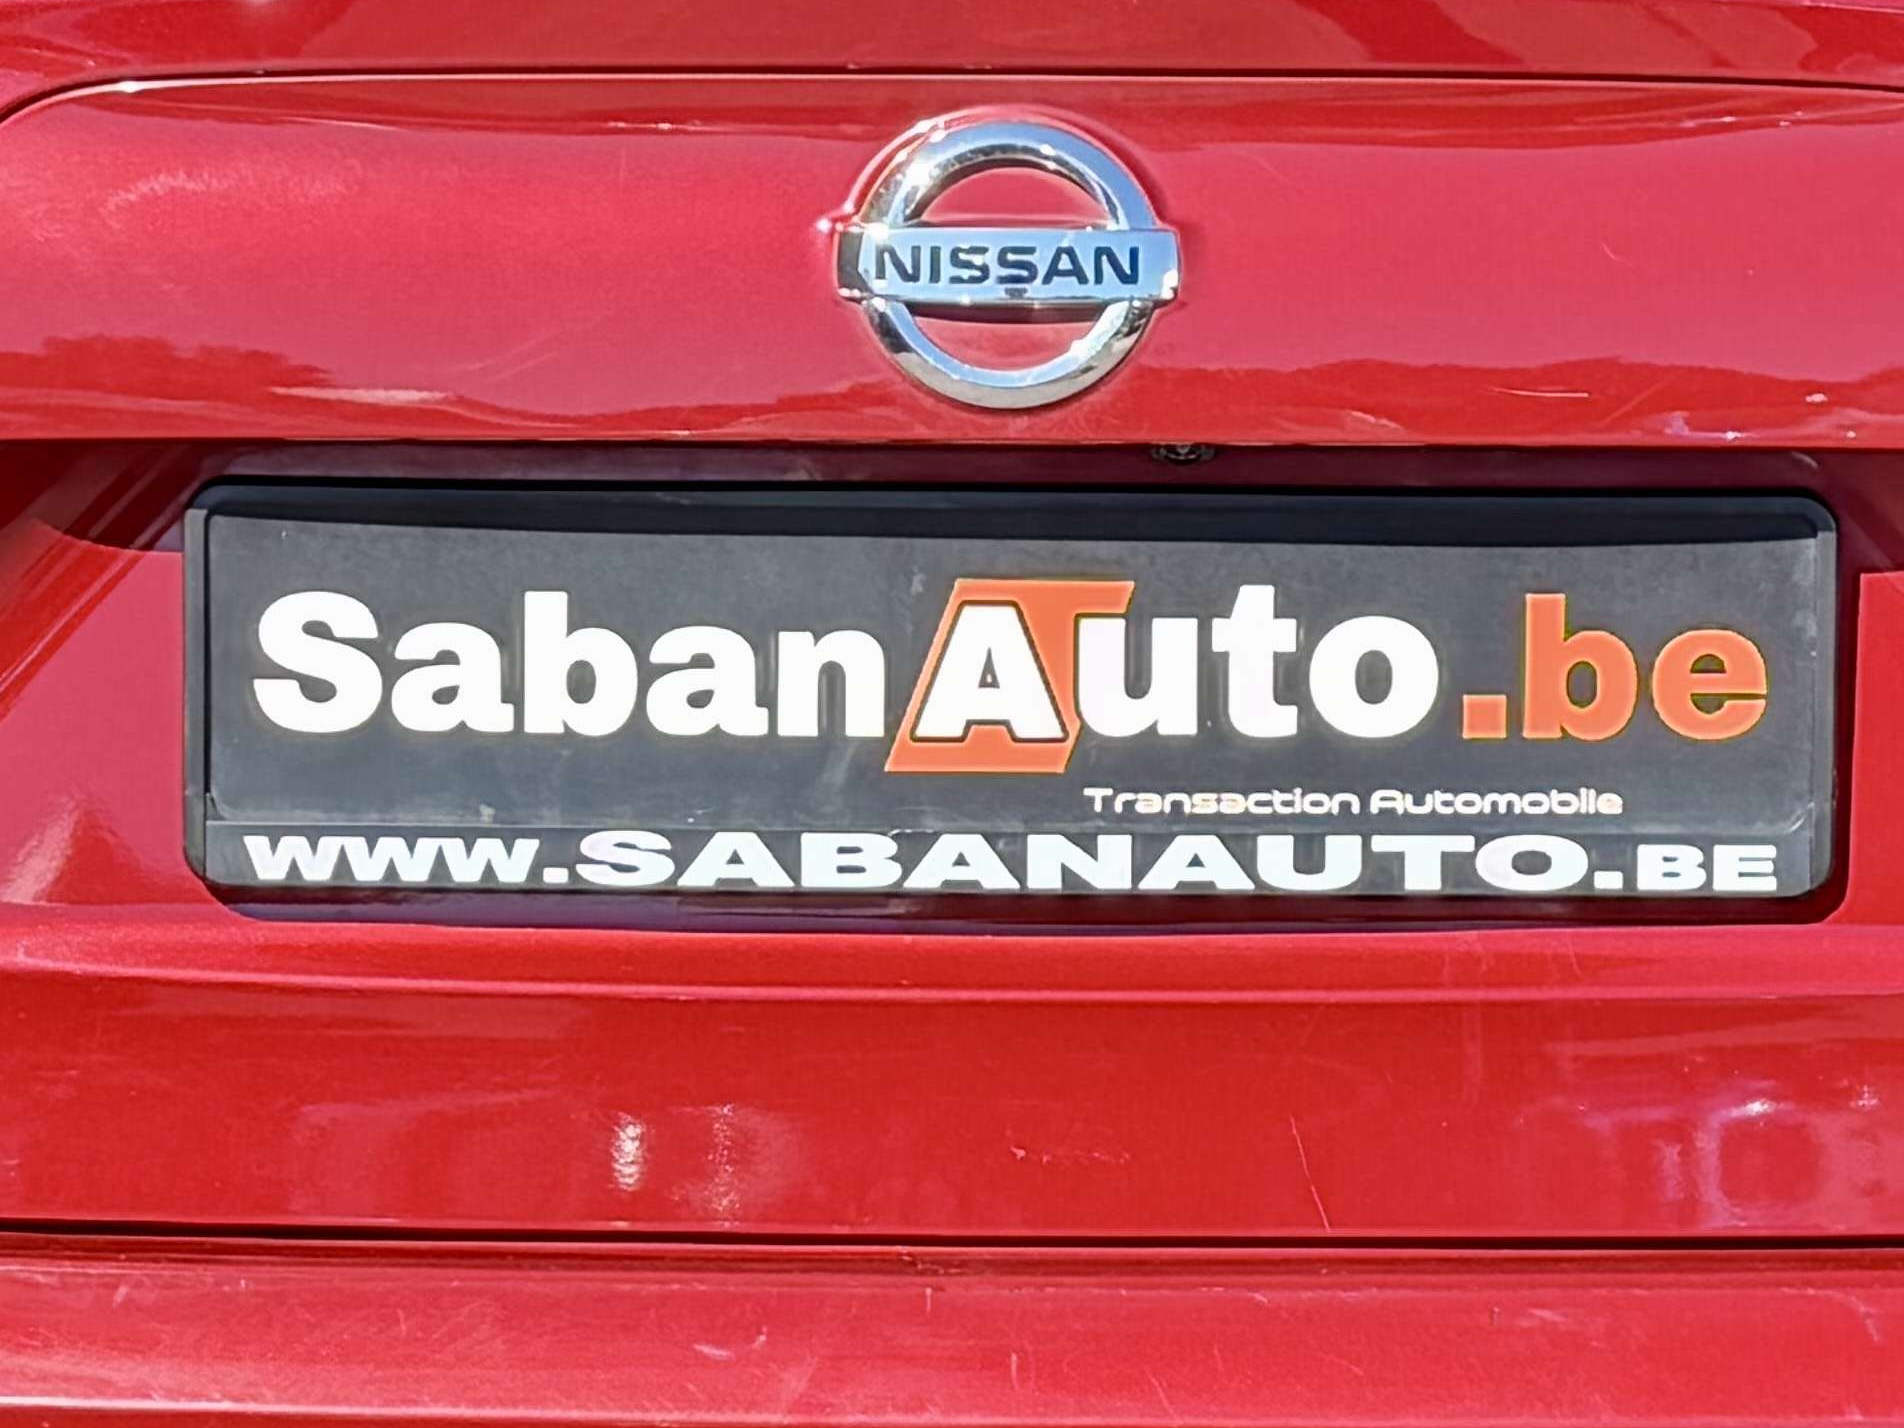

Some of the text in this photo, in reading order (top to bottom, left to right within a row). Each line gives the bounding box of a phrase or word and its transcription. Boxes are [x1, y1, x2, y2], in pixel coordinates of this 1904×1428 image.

[873, 244, 1141, 287] NISSAN
[1082, 785, 1625, 817] Transaction Automobile
